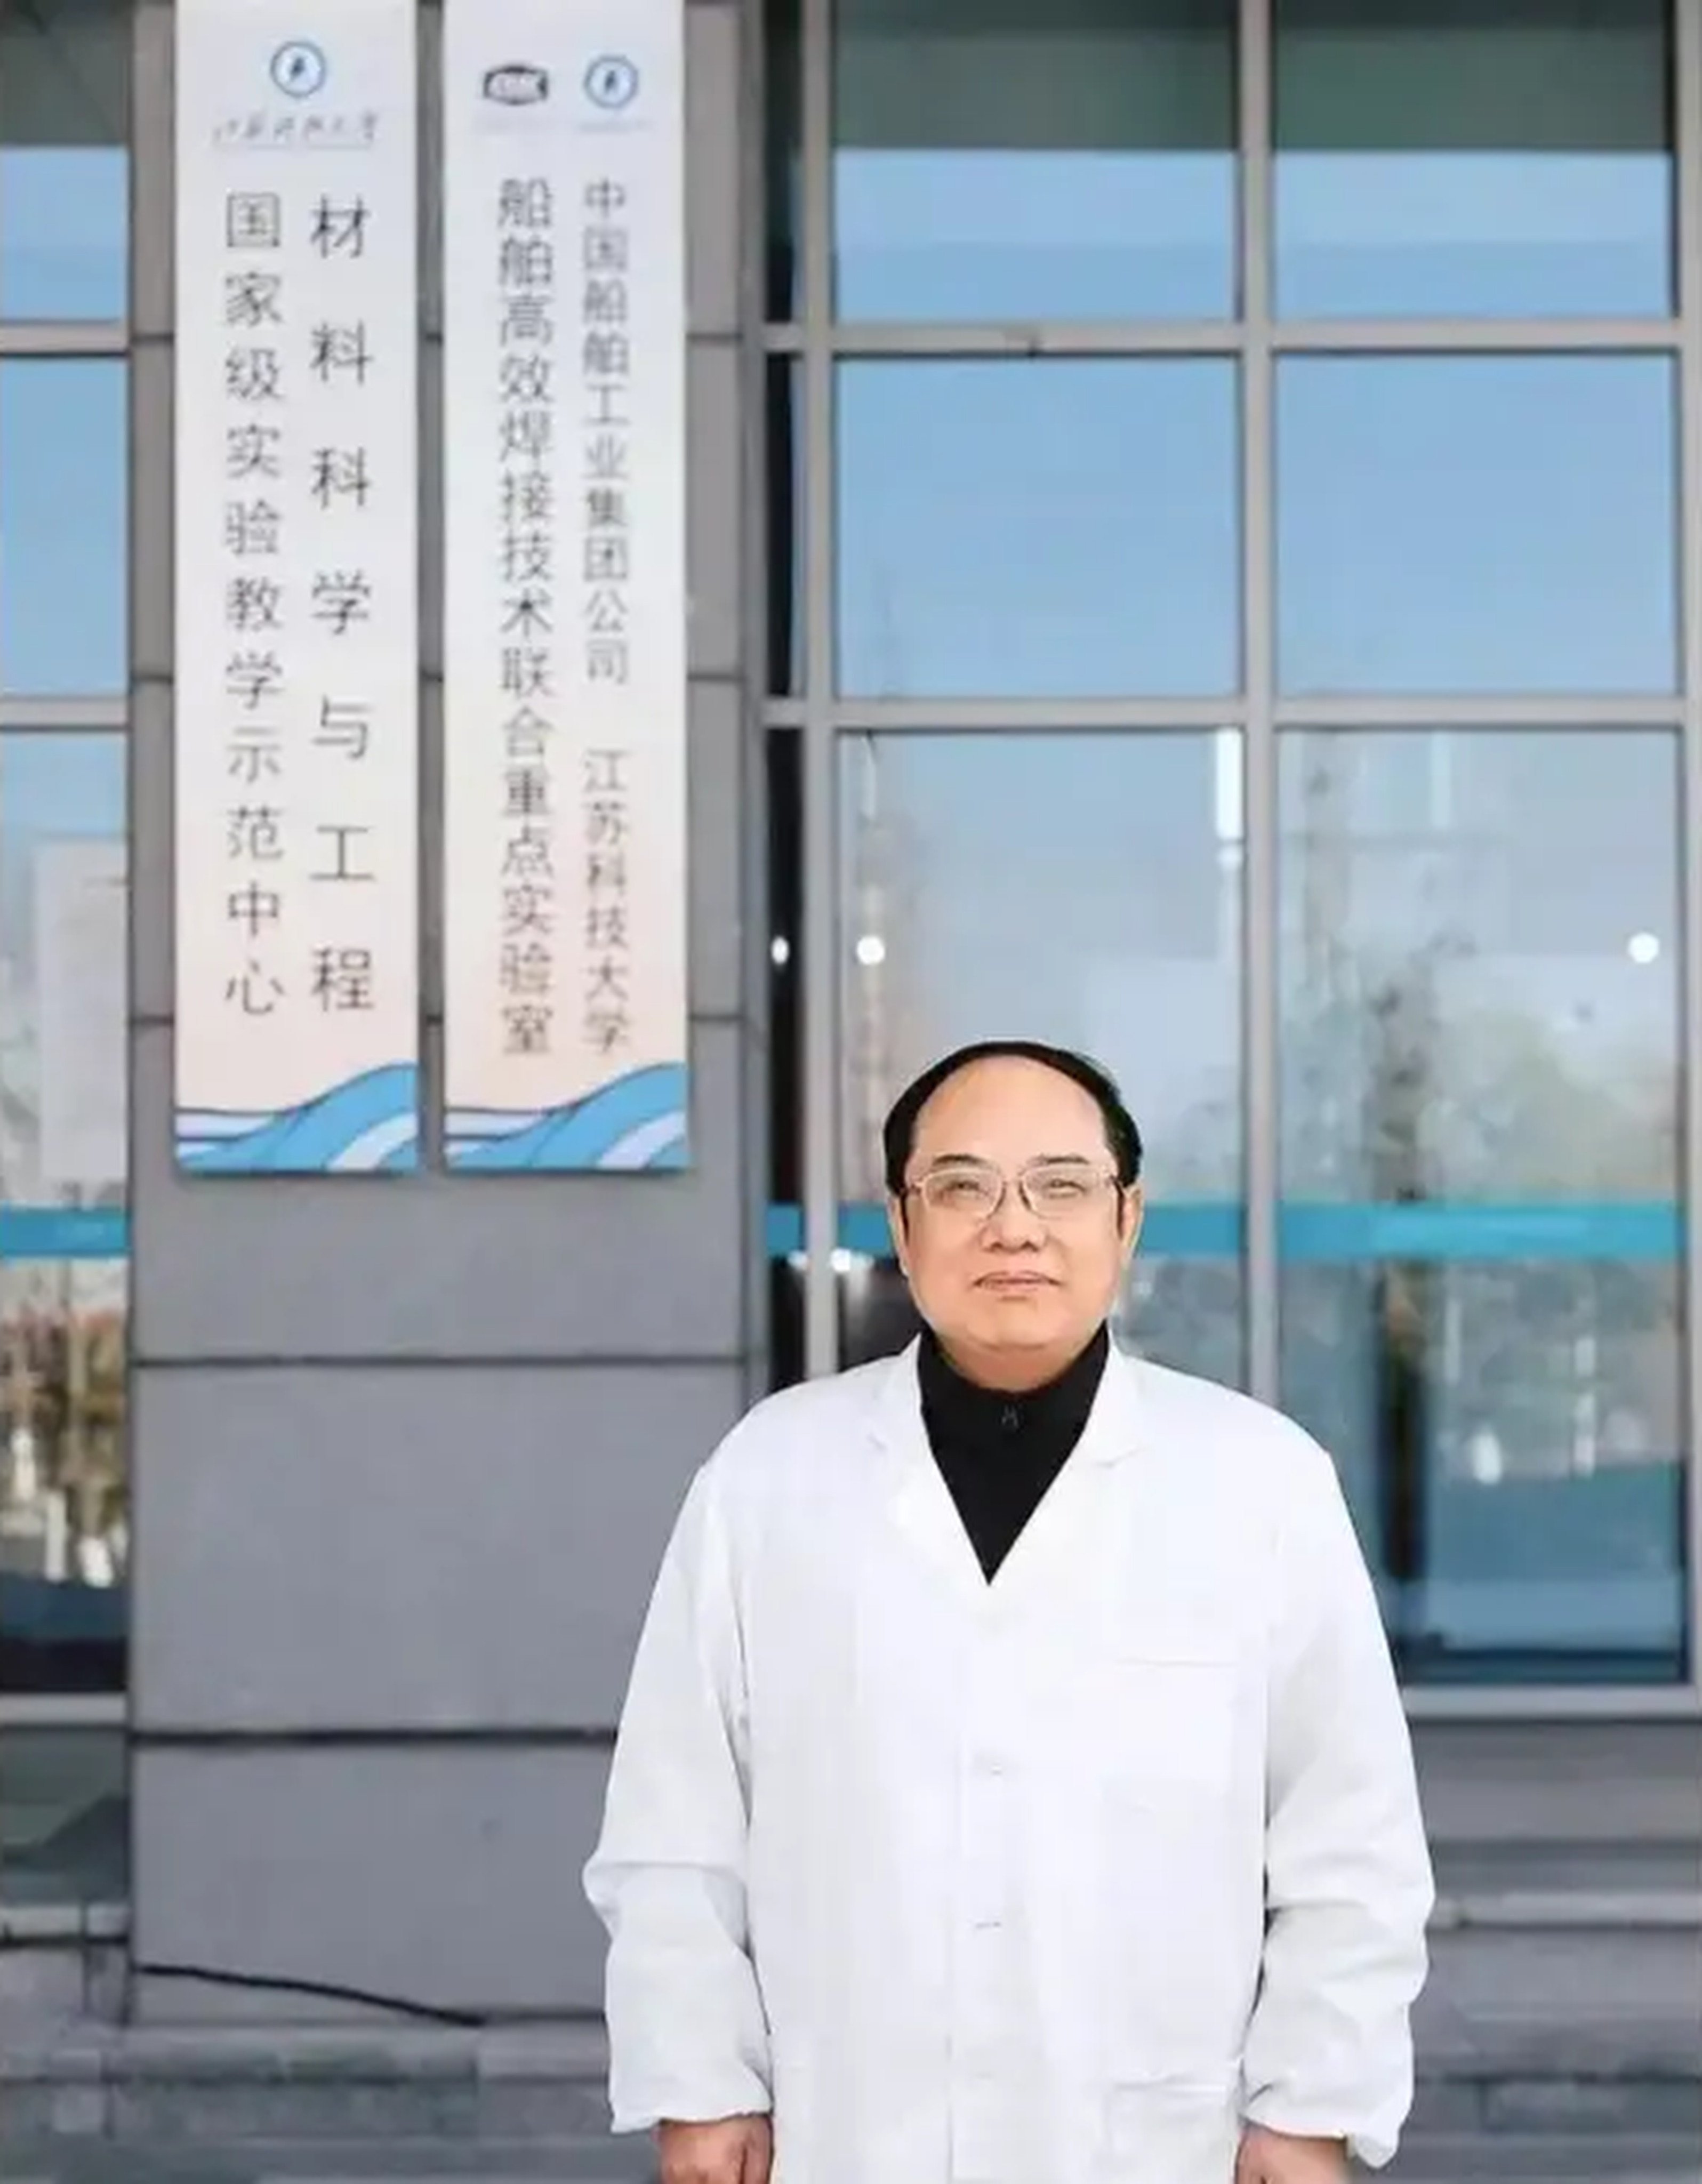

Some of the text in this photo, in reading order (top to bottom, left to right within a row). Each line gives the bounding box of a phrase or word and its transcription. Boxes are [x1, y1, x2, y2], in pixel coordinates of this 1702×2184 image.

[225, 192, 285, 1016] 国家级实验教学示范中心
[309, 194, 374, 1013] 材料科学与工程
[582, 179, 631, 686] 中国船舶工业集团公司
